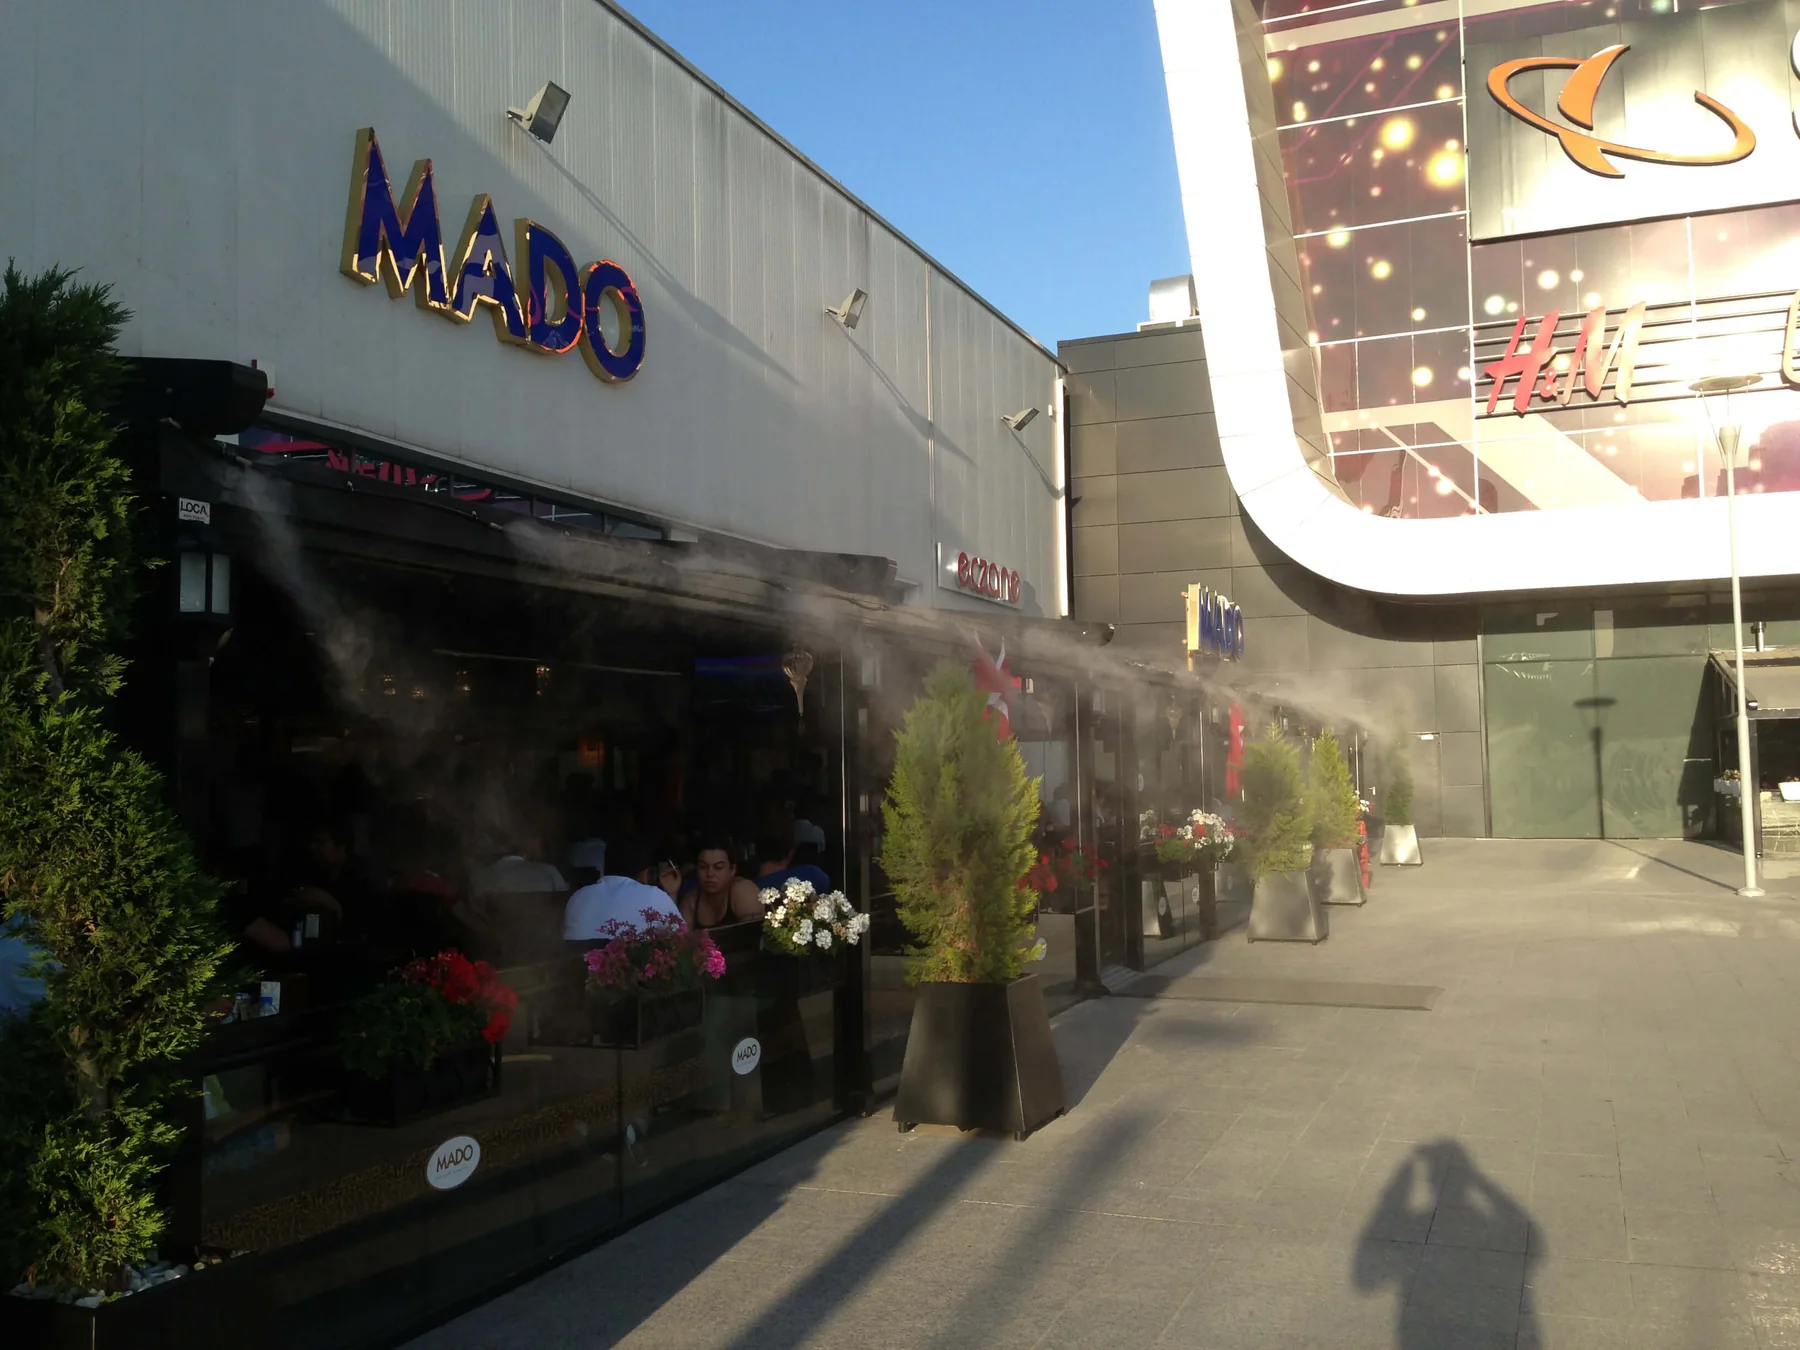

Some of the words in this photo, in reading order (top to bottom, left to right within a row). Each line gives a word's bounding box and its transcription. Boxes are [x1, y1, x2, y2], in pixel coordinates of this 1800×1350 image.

[340, 126, 646, 384] MADO
[1484, 301, 1646, 414] H&M
[180, 500, 208, 516] LOCA
[957, 551, 1021, 604] eczane
[1188, 582, 1245, 662] MADO
[736, 1043, 758, 1063] MADO
[436, 1144, 474, 1173] MADO
